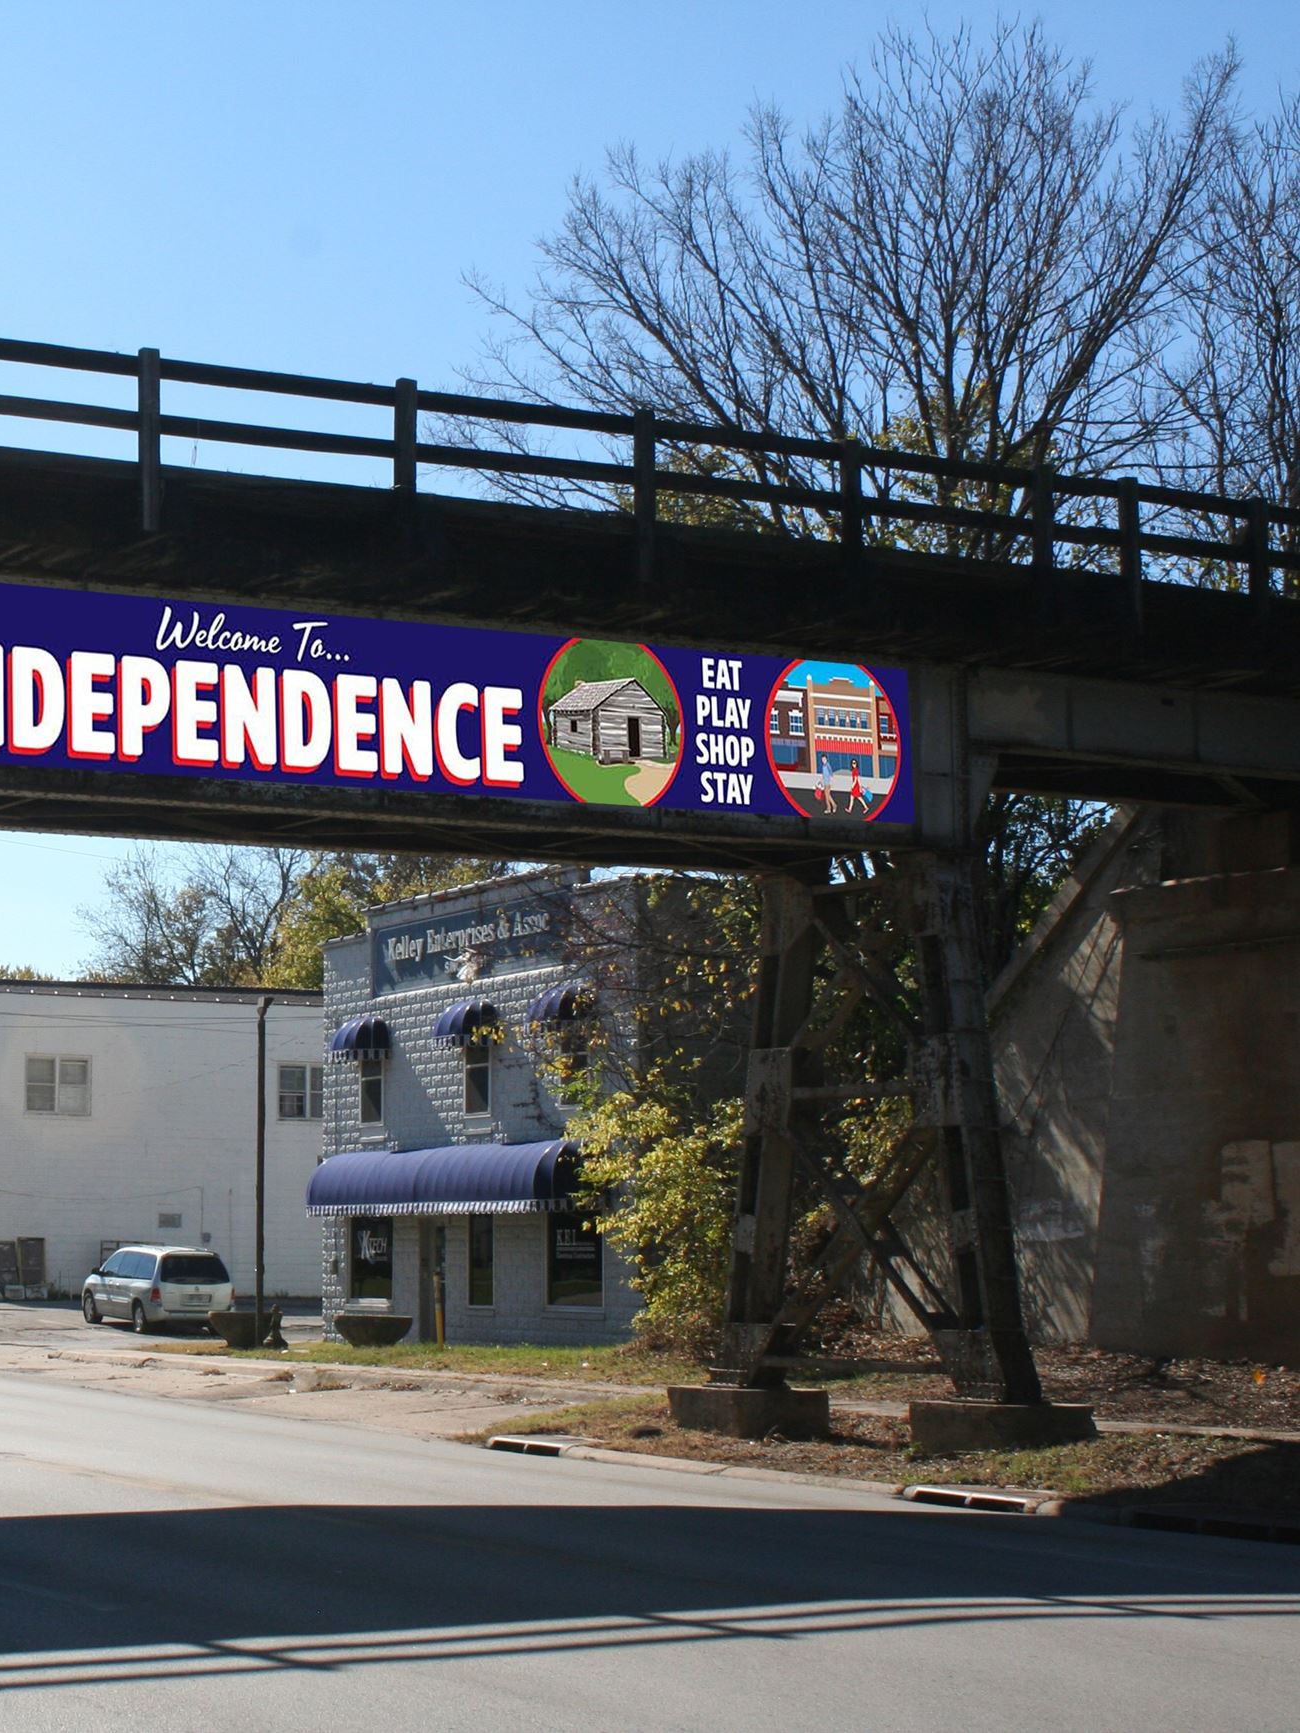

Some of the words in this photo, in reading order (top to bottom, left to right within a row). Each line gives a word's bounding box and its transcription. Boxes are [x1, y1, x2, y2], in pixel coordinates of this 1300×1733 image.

[155, 606, 282, 655] Welcome
[293, 621, 351, 662] To...
[701, 657, 743, 691] EAT
[696, 695, 752, 729] PLAY
[695, 733, 755, 768] SHOP
[700, 771, 753, 806] STAY
[387, 936, 425, 962] Kelley
[426, 920, 496, 954] Enterprises
